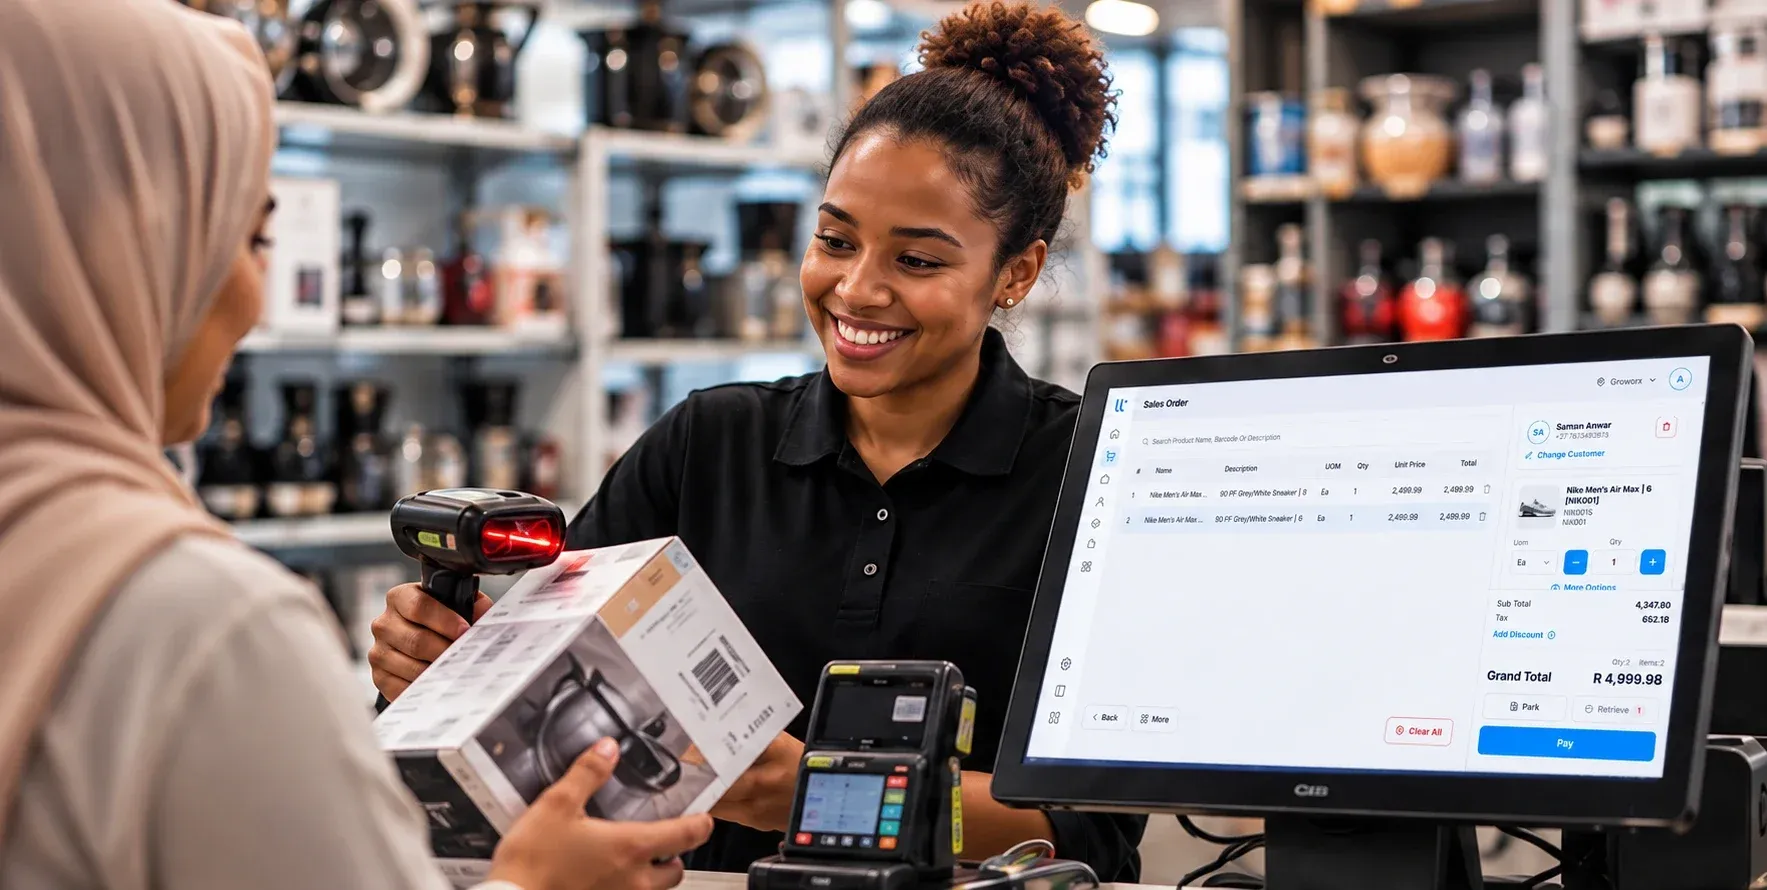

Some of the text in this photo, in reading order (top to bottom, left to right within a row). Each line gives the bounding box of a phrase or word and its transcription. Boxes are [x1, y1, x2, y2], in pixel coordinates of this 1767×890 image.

[1610, 376, 1643, 386] Groworx
[1676, 375, 1684, 383] A
[1143, 398, 1189, 409] Sales Order
[1556, 421, 1612, 431] Saman Anwar
[1533, 429, 1544, 437] SA
[1151, 437, 1172, 445] Search
[1172, 436, 1195, 445] Product
[1195, 436, 1213, 444] Name,
[1247, 433, 1281, 442] Description
[1537, 449, 1606, 460] Change Customer
[1324, 462, 1341, 470] UOM
[1357, 462, 1369, 471] Qty
[1394, 460, 1426, 469] Unit Price
[1460, 459, 1478, 467] Total
[1224, 464, 1258, 473] Description
[1321, 488, 1329, 496] Ea
[1392, 486, 1422, 495] 2,499.99
[1443, 485, 1474, 494] 2,499.99
[1566, 486, 1584, 494] Nike
[1585, 485, 1608, 494] Men's
[1609, 485, 1622, 493] Air
[1623, 484, 1640, 493] Max
[1317, 514, 1325, 522] Ea
[1388, 513, 1419, 522] 2,499.99
[1440, 512, 1471, 521] 2,499.99
[1609, 538, 1622, 546] Qty
[1611, 558, 1616, 566] 1
[1635, 601, 1671, 609] 4,347.80
[1642, 615, 1669, 623] 652.18
[1493, 630, 1543, 639] Add Discount
[1612, 659, 1630, 667] Qty:2
[1487, 670, 1552, 682] Grand Total
[1593, 673, 1663, 686] R 4,999.98
[1522, 703, 1540, 711] Park
[1597, 706, 1630, 714] Retrieve
[1409, 727, 1442, 736] Clear All
[1557, 739, 1574, 749] Pay
